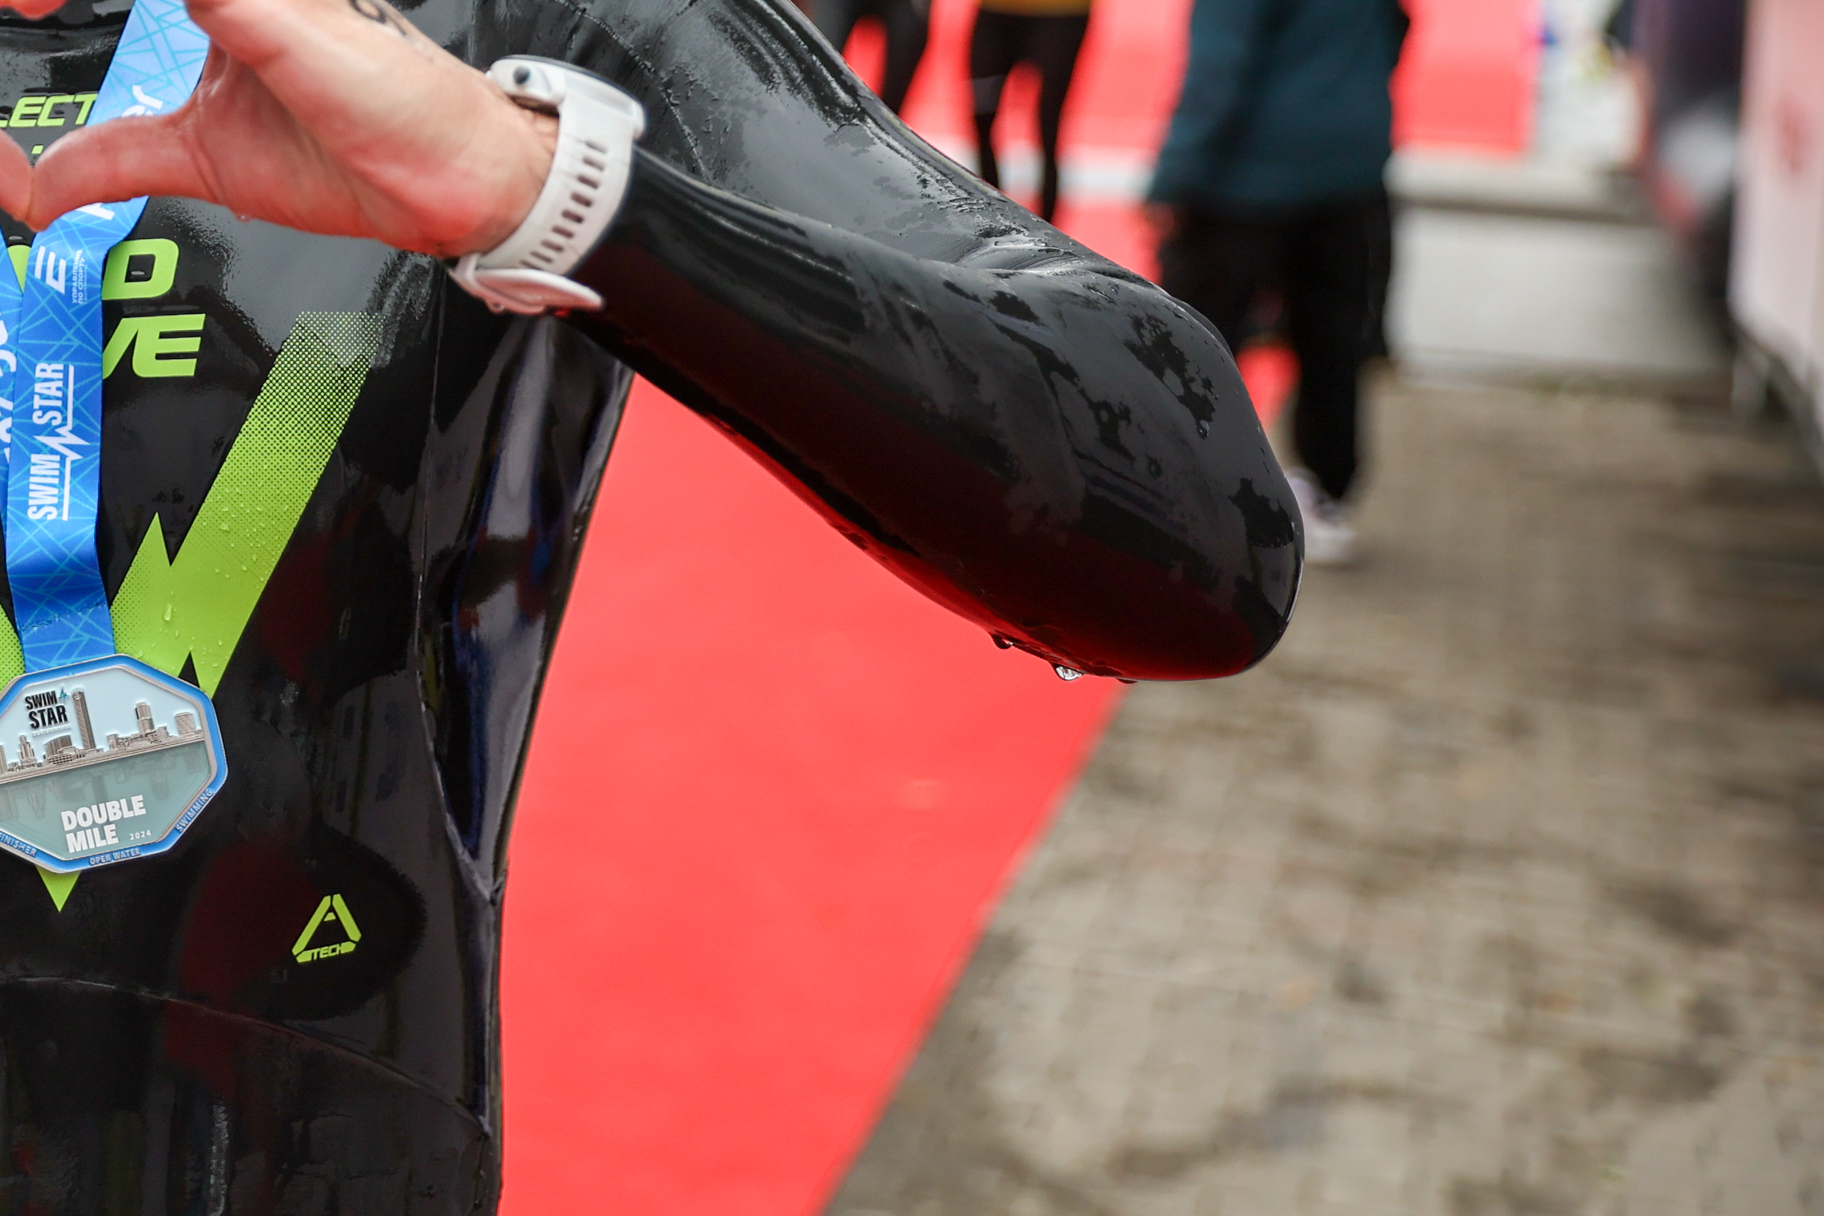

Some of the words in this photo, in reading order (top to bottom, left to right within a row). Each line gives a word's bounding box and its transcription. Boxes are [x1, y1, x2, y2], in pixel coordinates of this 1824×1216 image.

[78, 257, 86, 290] СПОРТУ
[78, 292, 84, 304] ПО
[32, 362, 65, 426] STAR
[27, 453, 60, 521] SWIM
[25, 690, 58, 710] SWIM
[28, 705, 68, 729] STAR
[60, 794, 147, 831] DOUBLE
[176, 787, 214, 833] SWIMMING
[65, 824, 119, 854] MILE
[129, 829, 152, 841] 2024
[89, 852, 112, 866] OPEN
[113, 847, 142, 862] WATER
